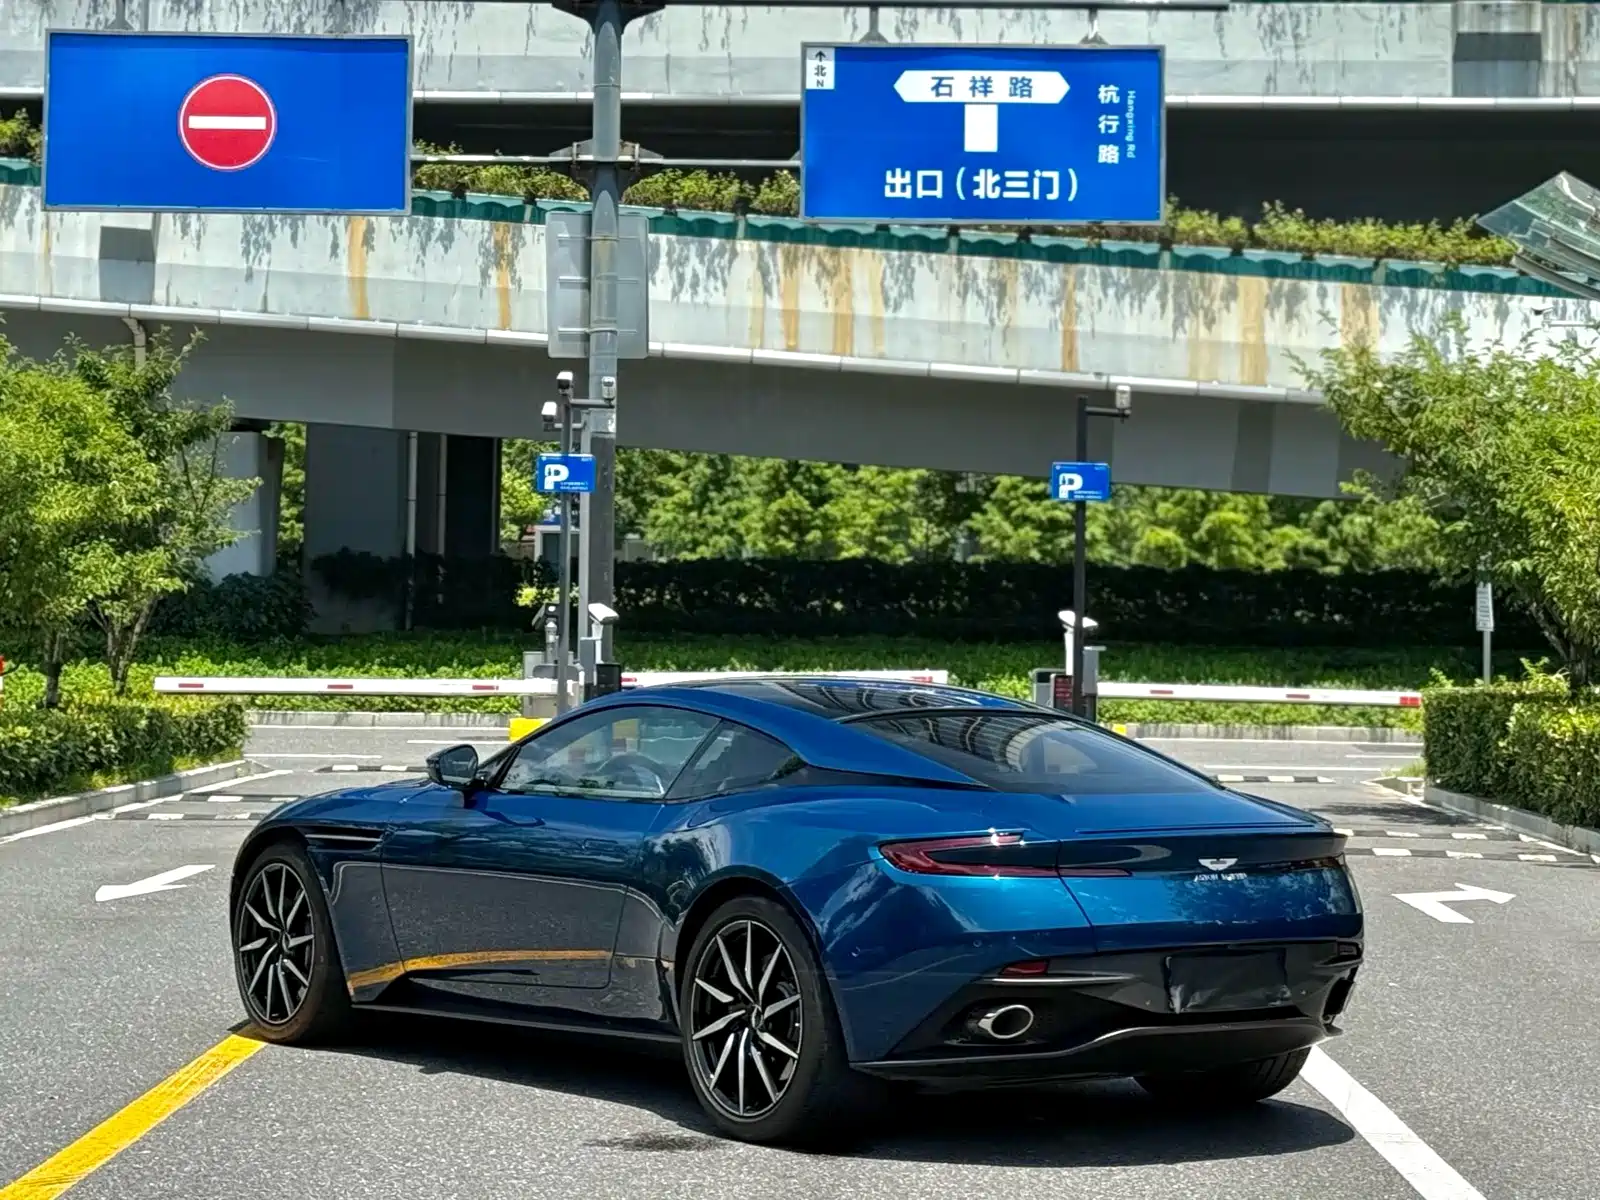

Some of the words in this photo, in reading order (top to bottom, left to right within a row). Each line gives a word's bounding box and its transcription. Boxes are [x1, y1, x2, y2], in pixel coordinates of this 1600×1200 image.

[814, 64, 827, 77] 北
[816, 79, 824, 87] N
[930, 76, 1033, 98] 石祥路
[1097, 84, 1120, 164] 杭行路
[1125, 90, 1136, 142] Hangxing
[1126, 143, 1136, 159] Rd
[544, 464, 569, 490] P
[1058, 472, 1083, 499] P
